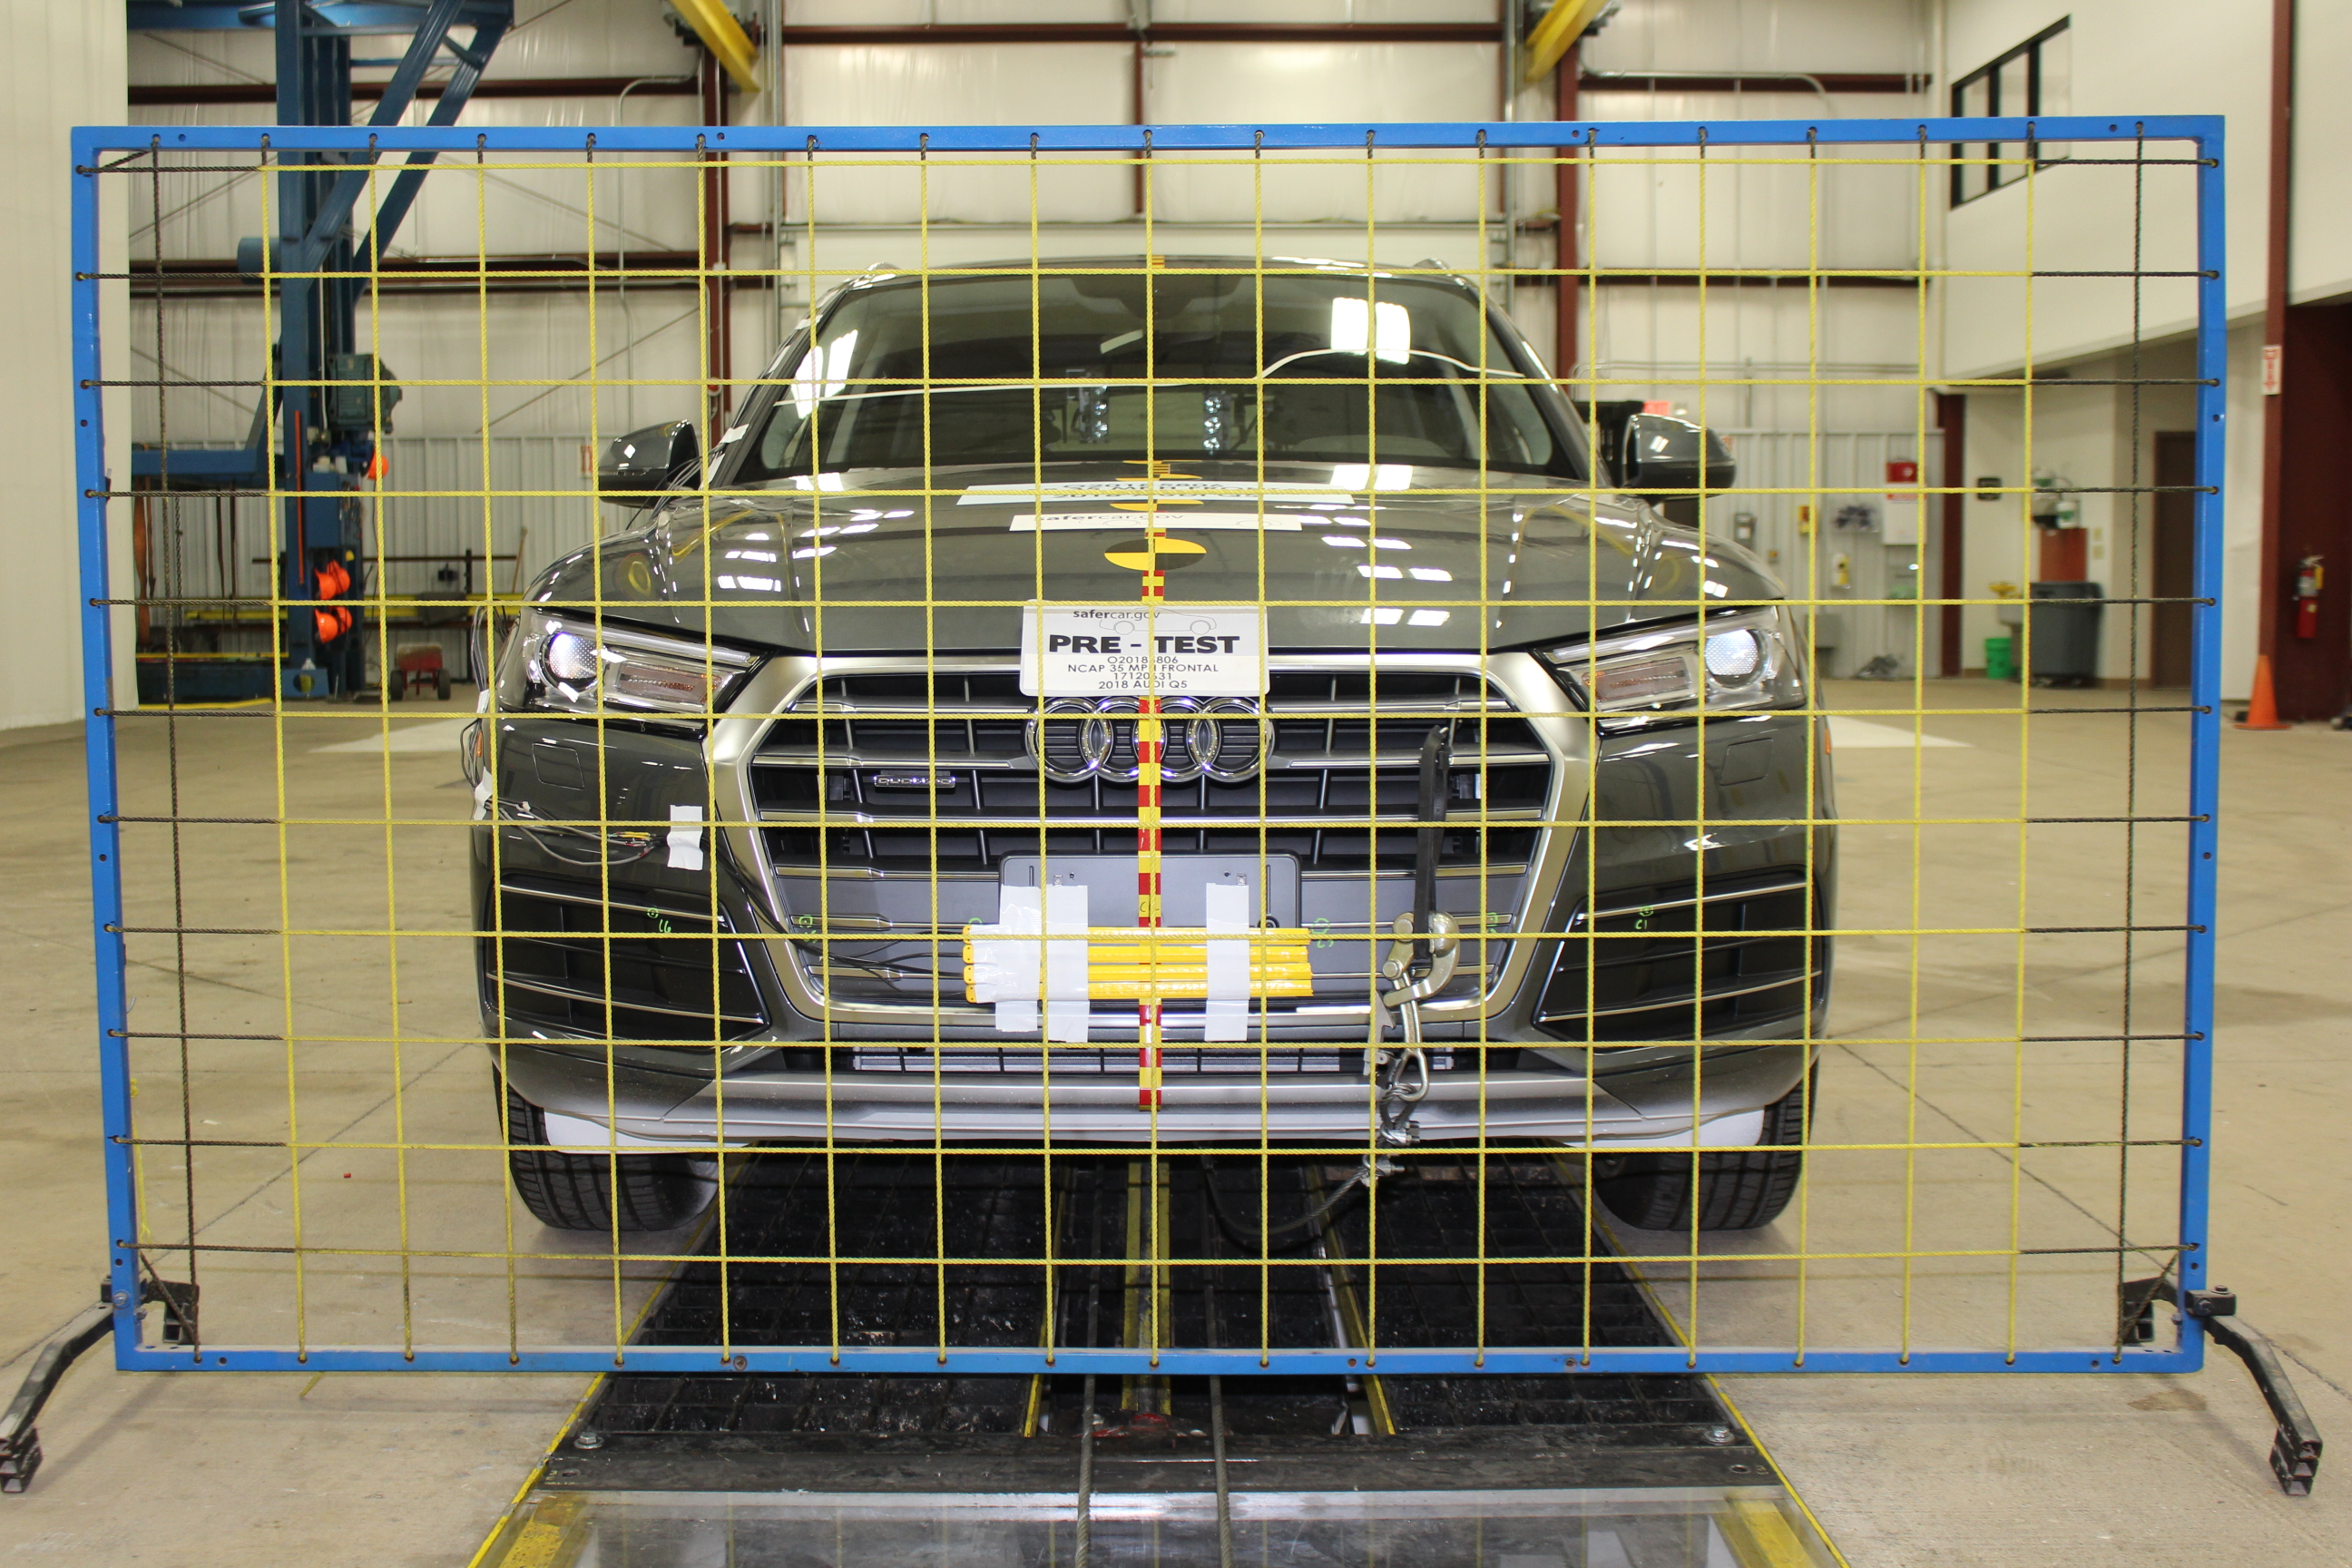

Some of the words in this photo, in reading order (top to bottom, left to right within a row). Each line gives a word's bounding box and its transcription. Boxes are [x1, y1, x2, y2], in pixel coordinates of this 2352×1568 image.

[1073, 609, 1161, 621] safercar.gov
[1049, 634, 1122, 653] PRE
[1153, 635, 1240, 654] TEST
[1068, 664, 1105, 672] NCAP
[1110, 664, 1124, 672] 35
[1161, 664, 1219, 672] FRONTAL
[1098, 681, 1129, 689] 2018
[1169, 681, 1188, 689] Q5
